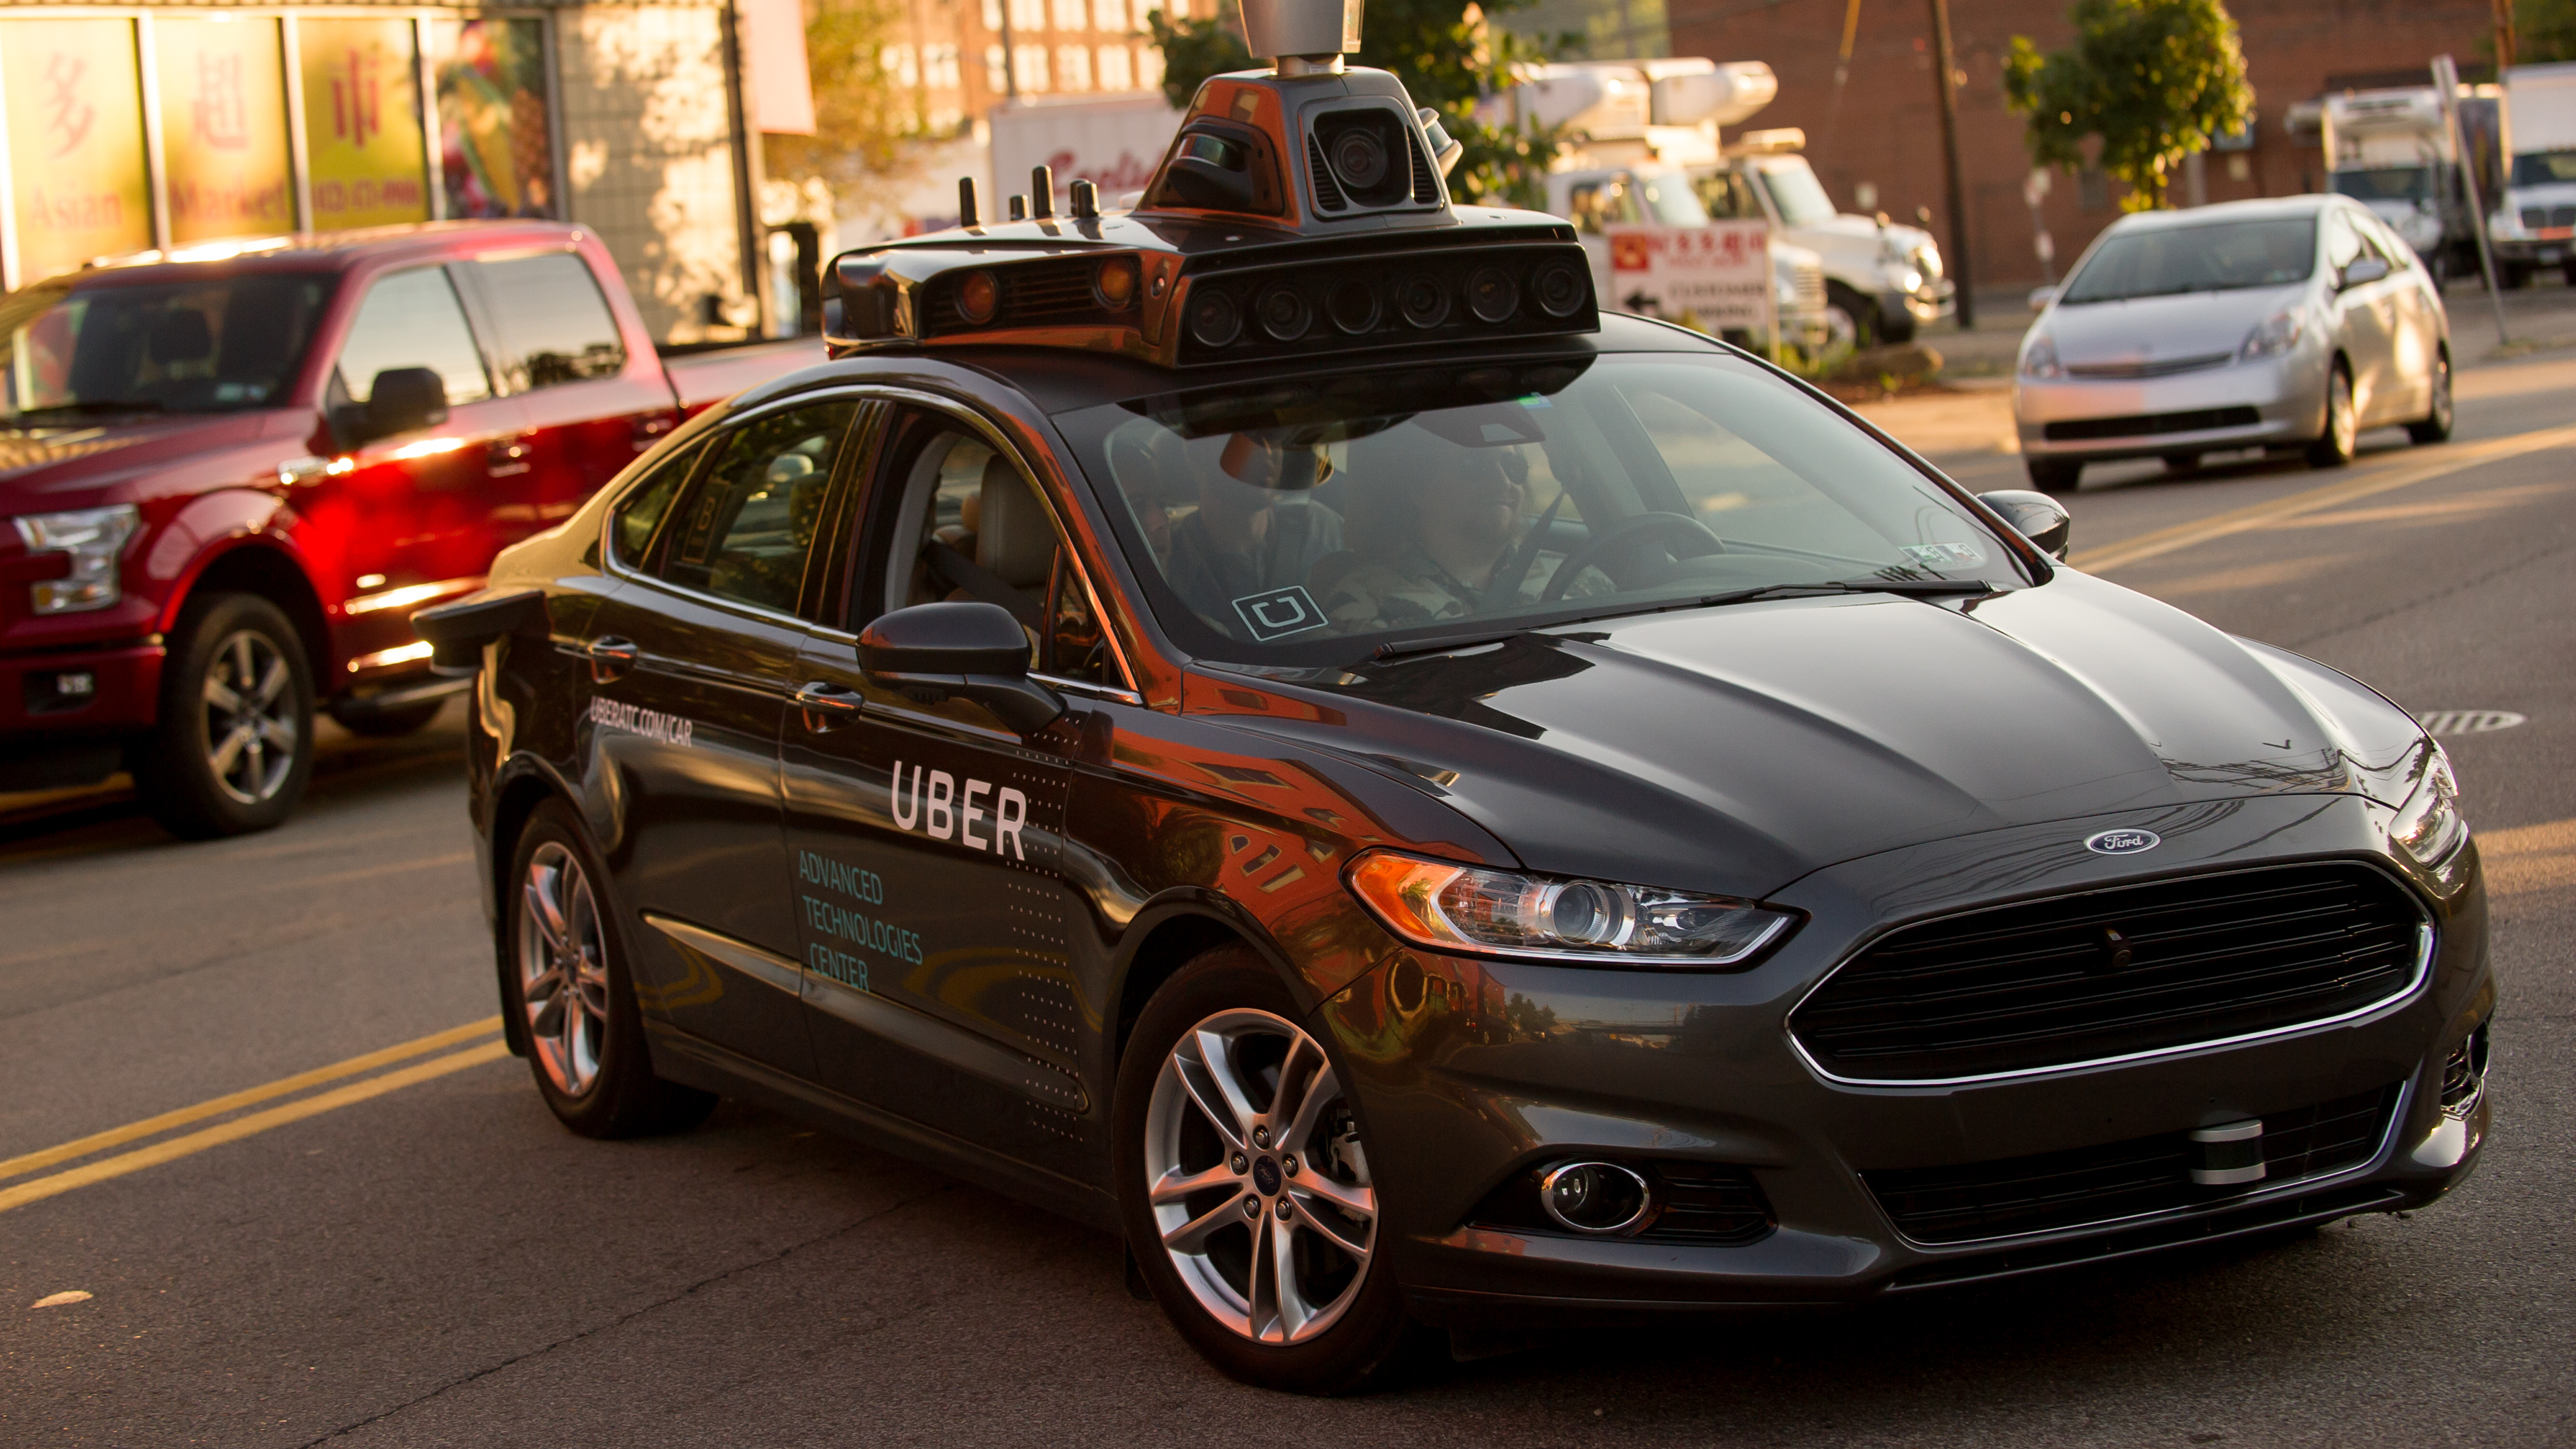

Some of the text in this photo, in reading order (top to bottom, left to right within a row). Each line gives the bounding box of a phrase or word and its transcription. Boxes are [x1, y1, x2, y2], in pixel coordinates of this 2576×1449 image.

[30, 183, 123, 230] Asian
[171, 177, 288, 223] Market
[590, 696, 692, 747] UBERATC.COM/CAR
[891, 760, 1027, 861] UBER
[2104, 834, 2144, 850] Ford
[799, 850, 883, 905] ADVANCED
[803, 896, 923, 965] TECHNOLOGIES
[810, 943, 870, 993] CENTER
